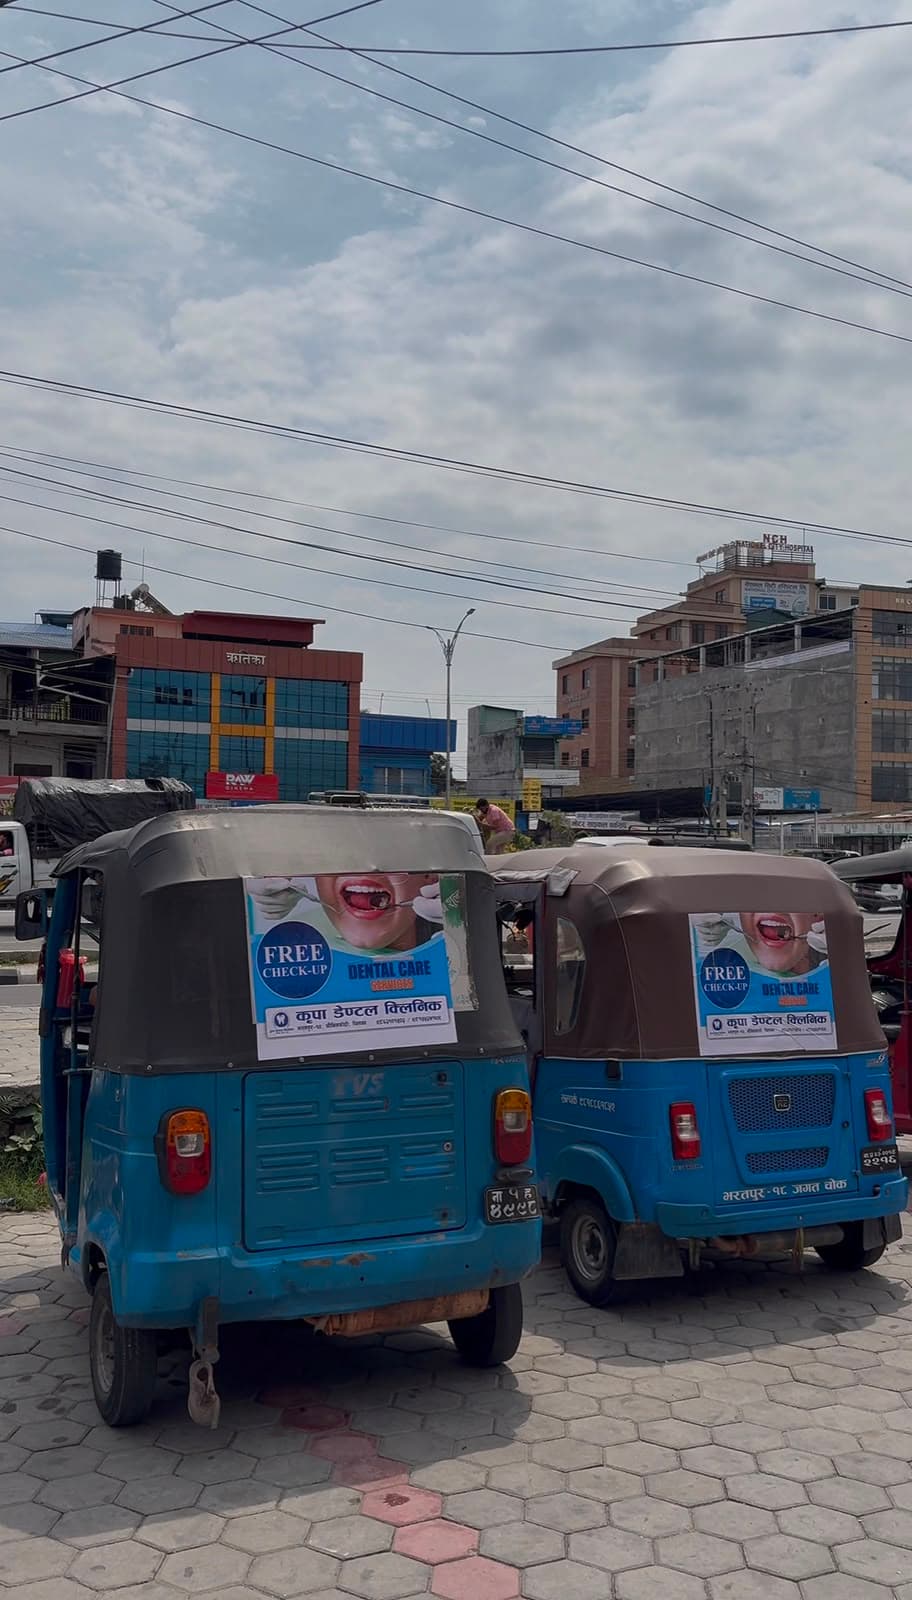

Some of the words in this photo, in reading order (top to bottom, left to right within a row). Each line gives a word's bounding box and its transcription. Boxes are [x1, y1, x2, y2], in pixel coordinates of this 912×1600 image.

[763, 534, 787, 543] NCH
[225, 774, 255, 785] RAW
[264, 944, 325, 964] FREE
[263, 964, 327, 978] CHECK-UP
[348, 963, 397, 979] DENTAL
[400, 961, 431, 976] CARE
[704, 966, 746, 981] FREE
[703, 982, 748, 992] CHECK-UP
[762, 983, 795, 996] DENTAL
[797, 982, 820, 995] CARE
[334, 1004, 379, 1019] डेण्टल
[384, 998, 443, 1015] क्लिनिक
[331, 1072, 385, 1096] TVS
[863, 1154, 897, 1167] २२१६
[792, 1182, 821, 1195] जगत
